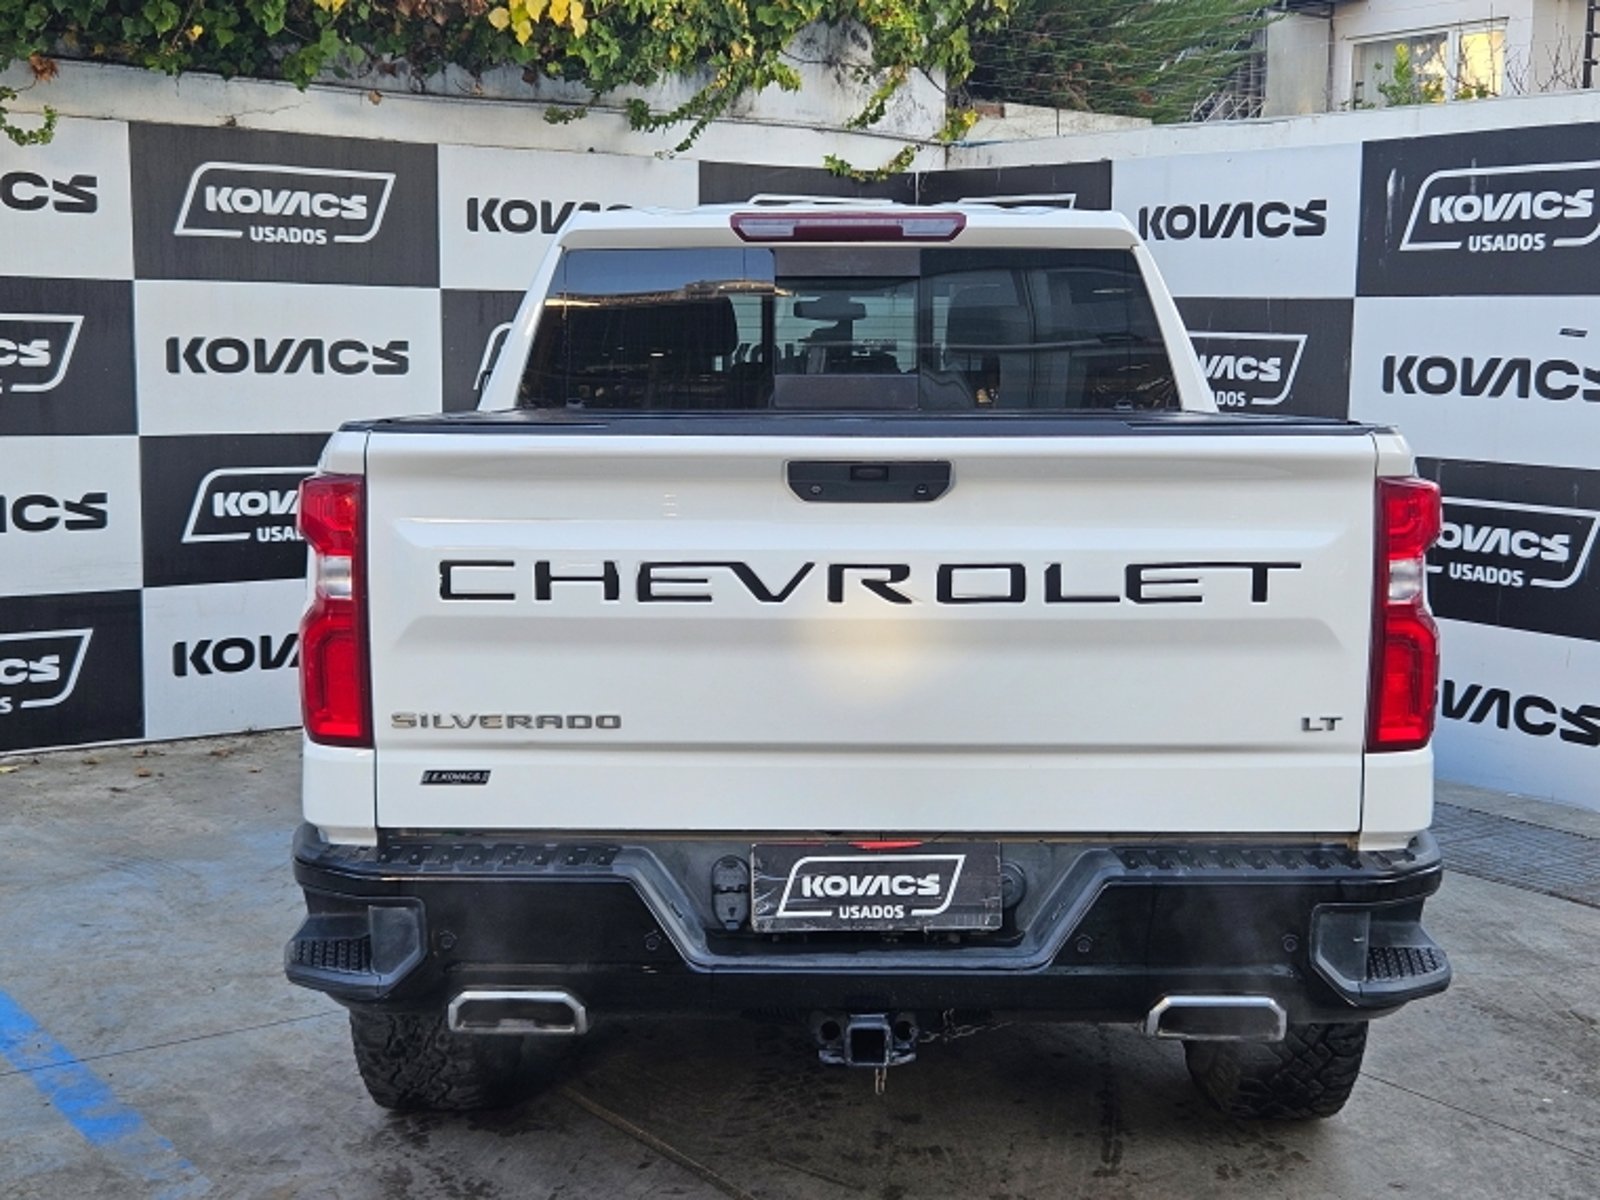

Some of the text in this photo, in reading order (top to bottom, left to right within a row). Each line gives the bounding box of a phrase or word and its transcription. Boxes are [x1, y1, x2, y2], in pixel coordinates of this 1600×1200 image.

[205, 185, 367, 219] KOVACS
[1429, 189, 1594, 224] KOVACS
[1138, 199, 1327, 240] KOVACS
[250, 226, 327, 245] USADOS
[1468, 233, 1546, 252] USADOS
[165, 336, 409, 375] KOVACS
[1199, 354, 1281, 382] VACS
[1216, 391, 1246, 407] DOS
[212, 489, 298, 517] KOV
[256, 526, 304, 542] USA
[1432, 522, 1570, 563] OVACS
[439, 560, 1302, 604] CHEVROLET
[1449, 562, 1524, 588] USADOS
[172, 634, 300, 677] KOV
[391, 713, 622, 729] SILVERADO
[1301, 717, 1343, 732] LT
[1441, 679, 1600, 747] VACS
[801, 874, 940, 898] KOVACS
[839, 905, 904, 919] USADOS
